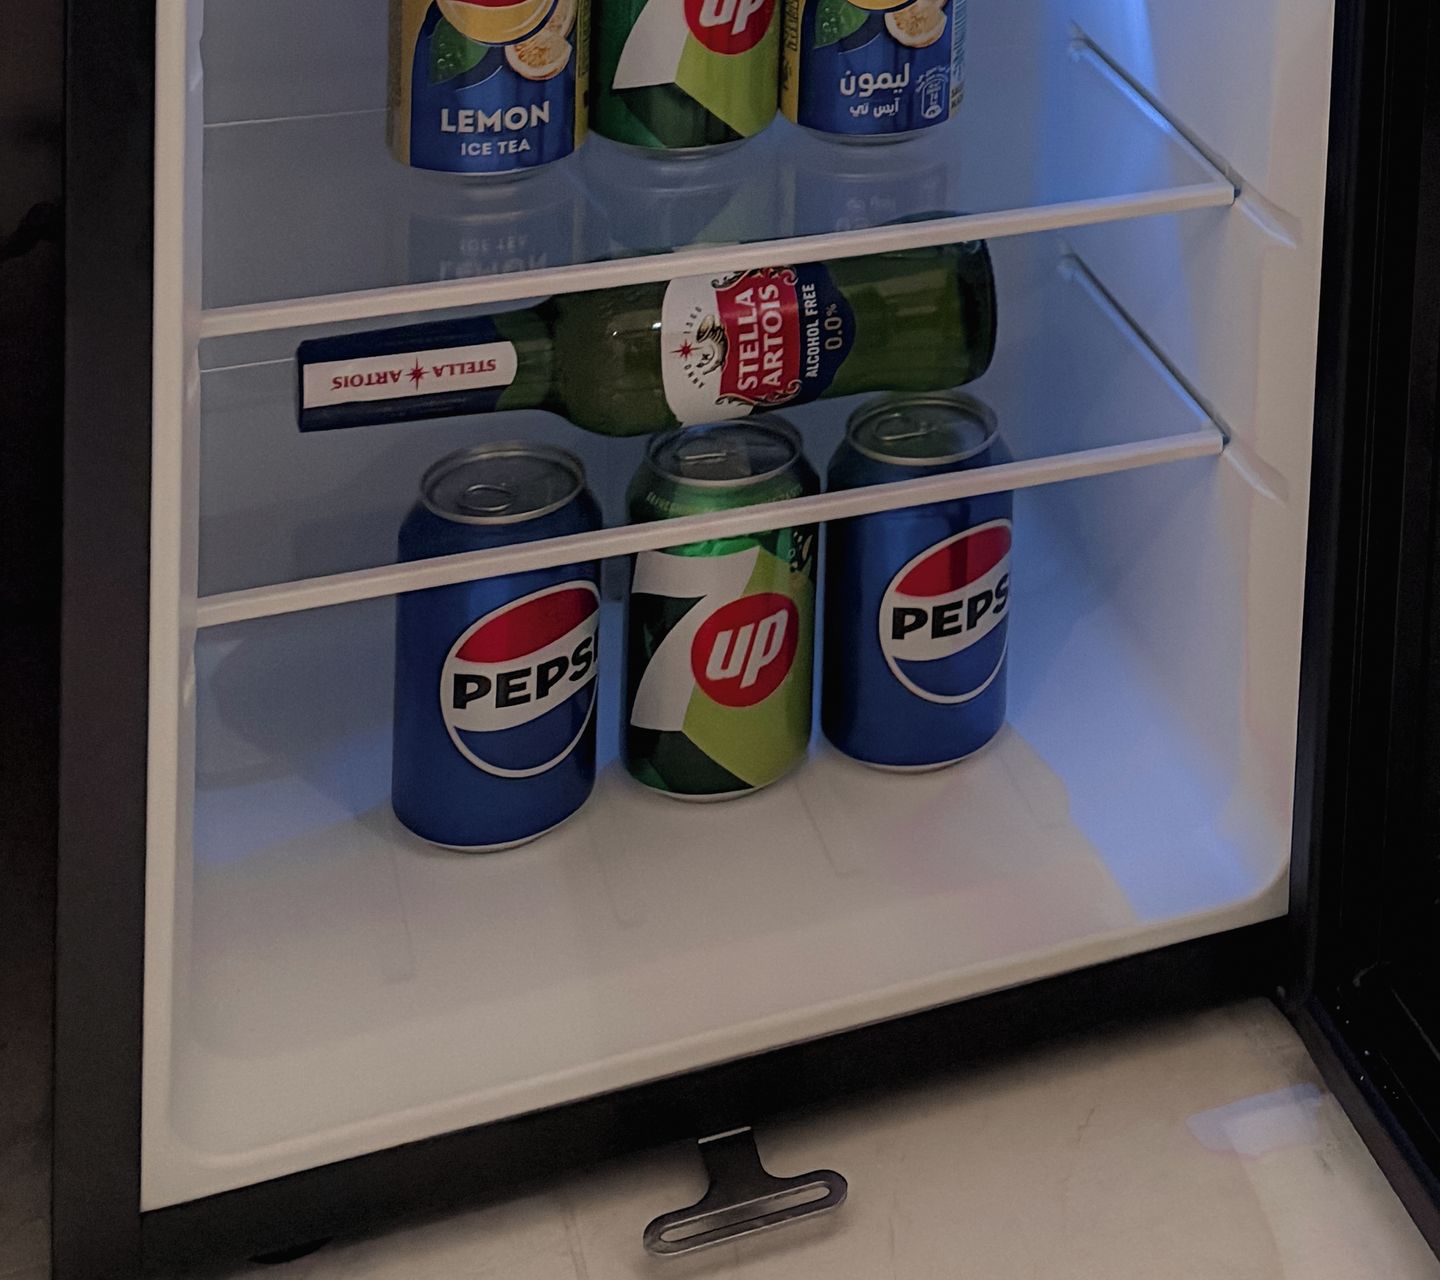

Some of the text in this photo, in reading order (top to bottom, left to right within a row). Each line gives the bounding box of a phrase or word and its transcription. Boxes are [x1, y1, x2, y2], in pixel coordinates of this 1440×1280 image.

[839, 62, 911, 98] ليمون
[440, 100, 550, 134] LEMON
[460, 138, 531, 157] ICE TEA
[734, 287, 761, 391] STELLA
[758, 283, 784, 387] ARTOIS
[801, 283, 820, 378] ALCOHOL FREE
[330, 358, 497, 391] STELLA ARTOIS
[892, 572, 1009, 640] PEPS
